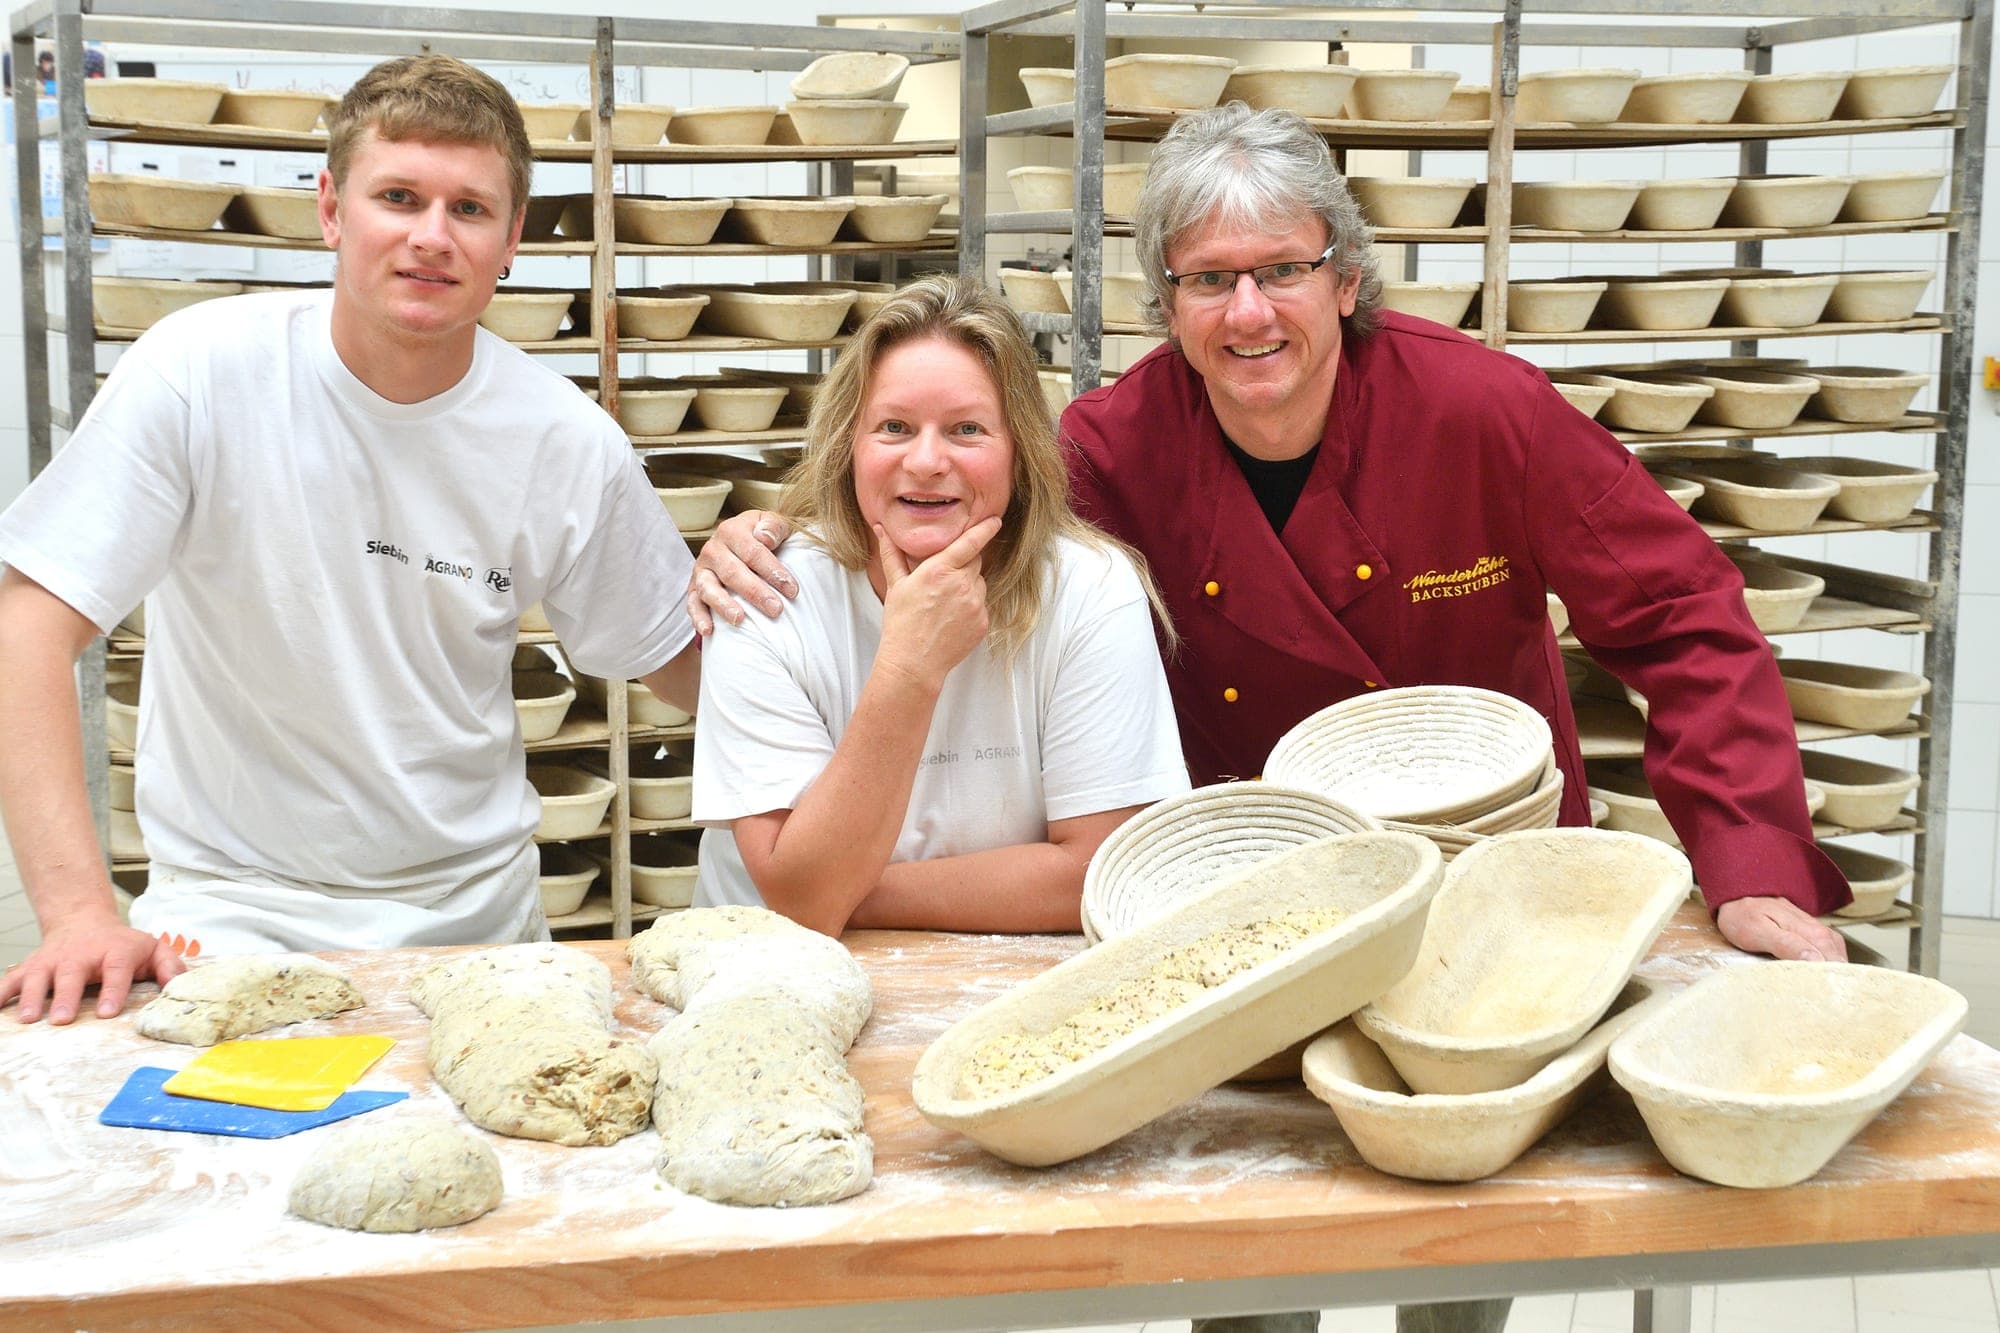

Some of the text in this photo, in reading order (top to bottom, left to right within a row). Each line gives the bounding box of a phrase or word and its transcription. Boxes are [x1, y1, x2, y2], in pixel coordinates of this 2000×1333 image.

[366, 541, 409, 565] Siebin
[424, 558, 473, 580] AGRANO
[1411, 568, 1512, 603] BACKSTUBEN
[974, 746, 1023, 760] AGRAN
